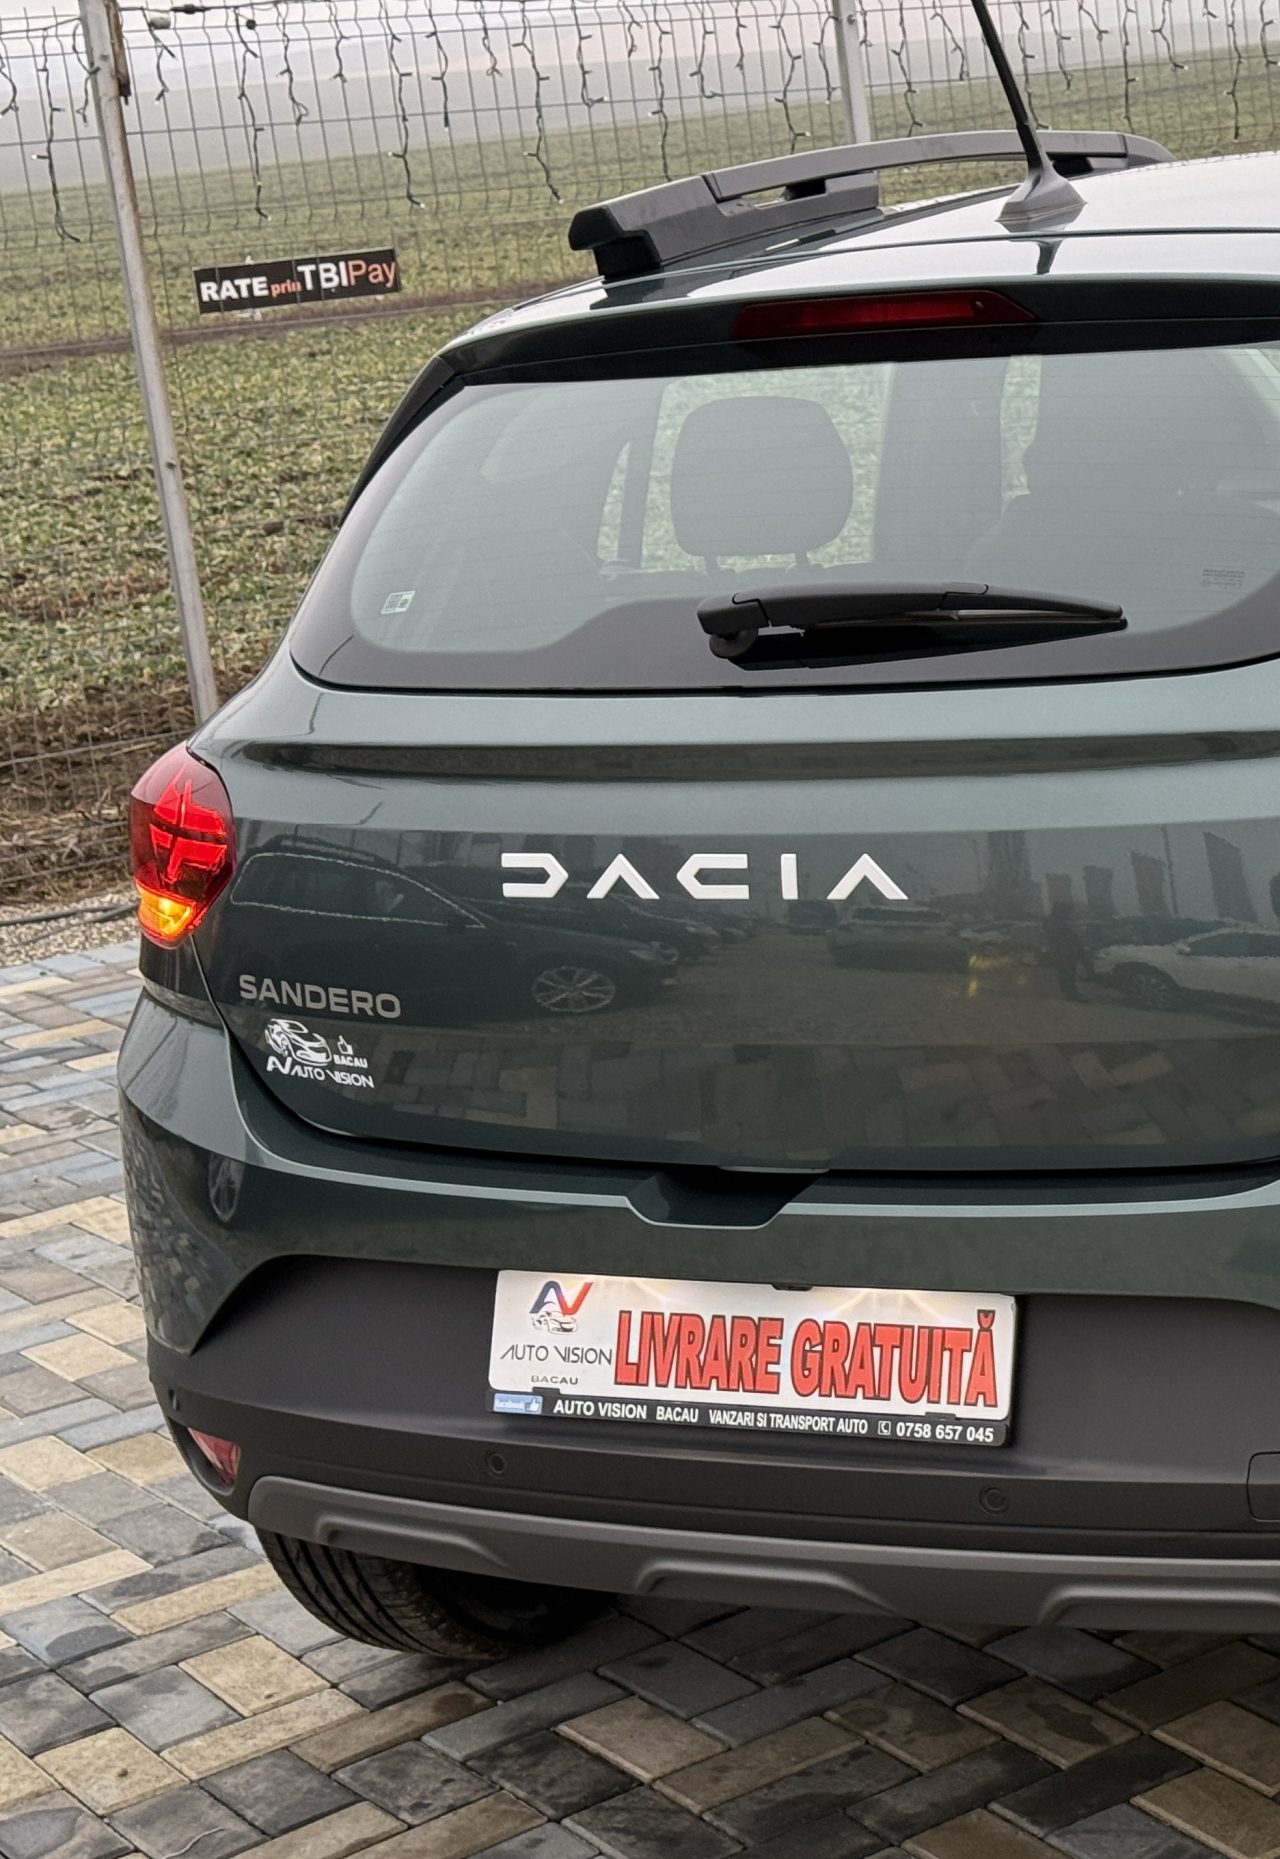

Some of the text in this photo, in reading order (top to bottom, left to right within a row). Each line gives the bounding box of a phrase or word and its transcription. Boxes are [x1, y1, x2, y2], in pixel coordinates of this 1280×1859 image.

[199, 275, 270, 302] RATE
[270, 279, 303, 298] prin
[501, 852, 909, 900] DACIA
[239, 974, 401, 1019] SANDERO
[333, 1054, 368, 1068] BACAU
[290, 1065, 325, 1081] AUTO
[325, 1069, 375, 1088] VISION
[500, 1344, 612, 1365] AUTO VISION
[614, 1309, 998, 1408] LIVRARE GRATUITĂ
[531, 1375, 578, 1385] BACAU
[553, 1399, 994, 1443] AUTO VISION BACAU VANZARI SI TRANSPORT AUTO 0758 657 045
